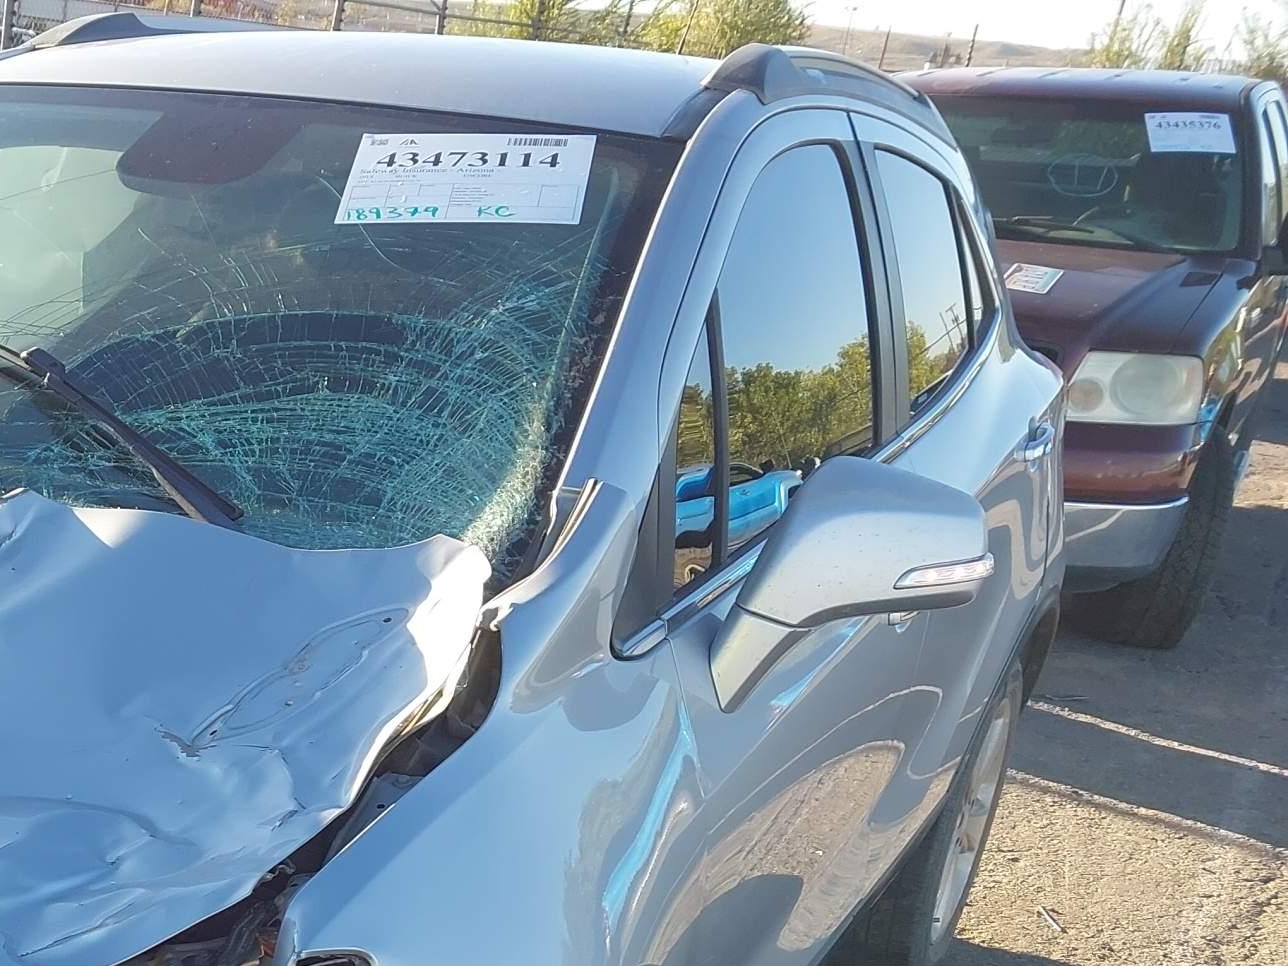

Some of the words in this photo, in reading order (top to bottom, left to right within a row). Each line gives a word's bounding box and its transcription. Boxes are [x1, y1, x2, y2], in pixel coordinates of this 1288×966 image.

[1154, 120, 1222, 129] 43435376
[376, 151, 560, 168] 43473114
[477, 206, 515, 217] KC
